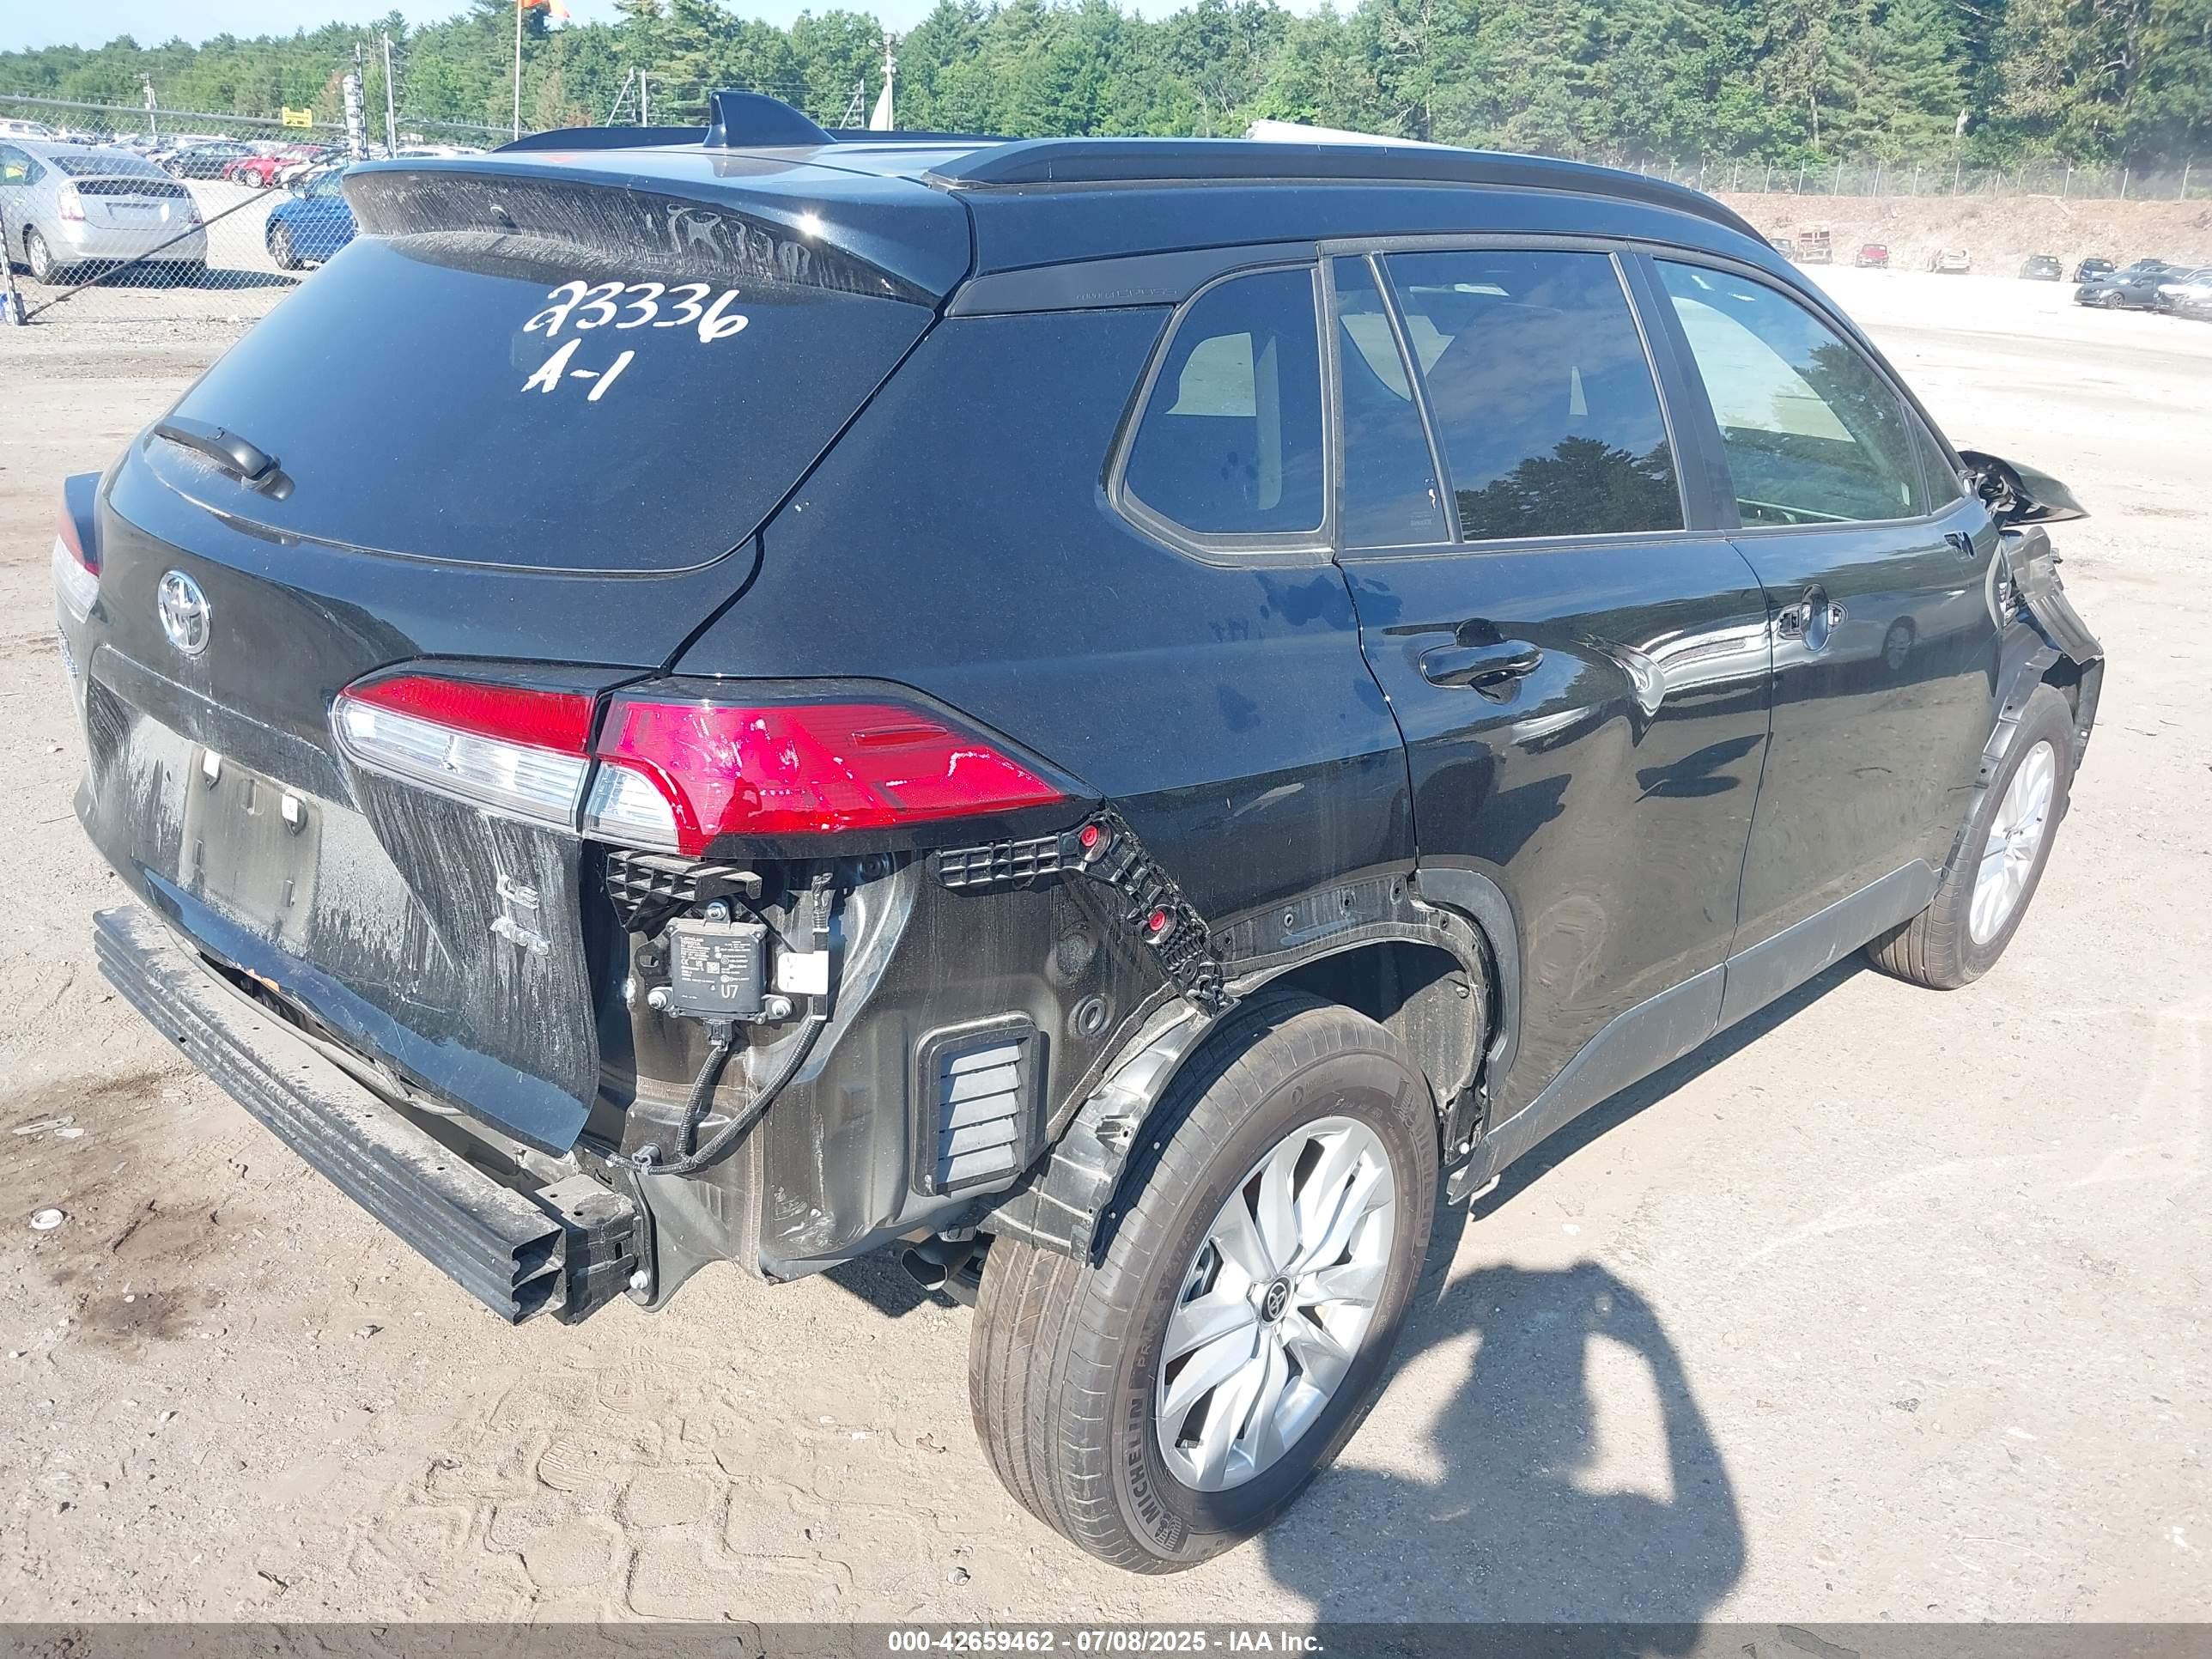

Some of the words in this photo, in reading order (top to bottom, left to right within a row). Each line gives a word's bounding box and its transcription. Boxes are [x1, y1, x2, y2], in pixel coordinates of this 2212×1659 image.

[523, 280, 750, 343] 23336
[520, 337, 635, 401] A-1
[721, 984, 738, 999] U7
[1128, 1397, 1161, 1525] MICHELIN
